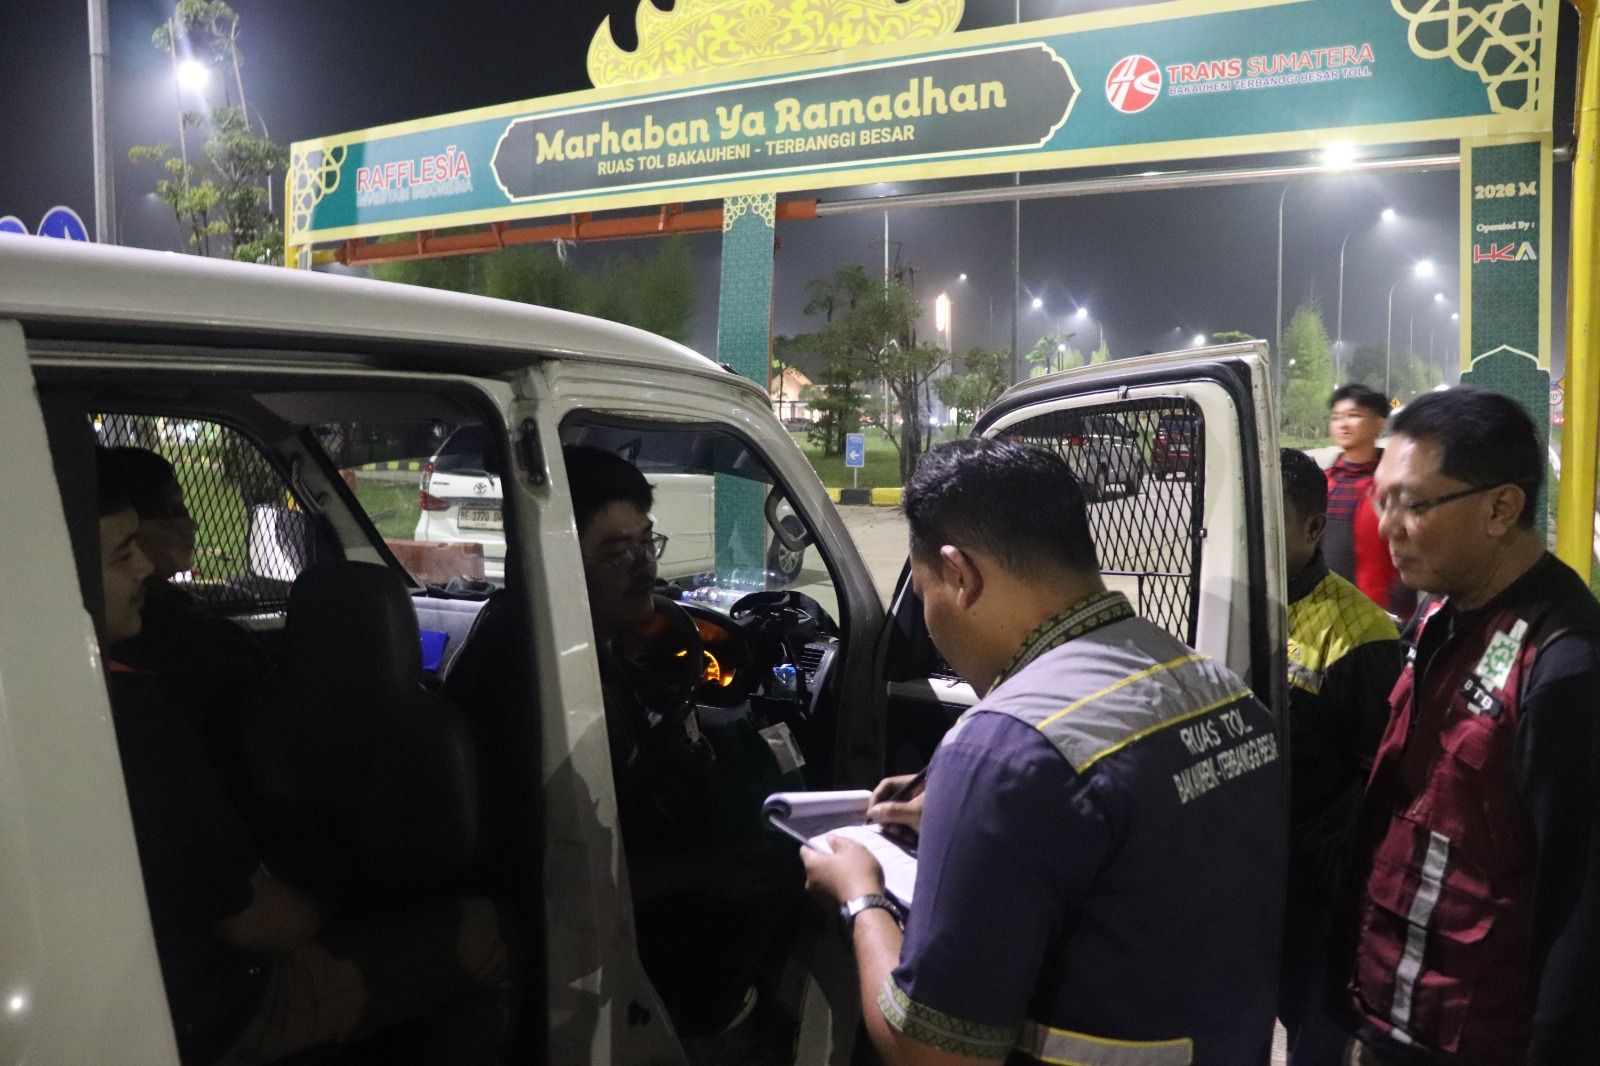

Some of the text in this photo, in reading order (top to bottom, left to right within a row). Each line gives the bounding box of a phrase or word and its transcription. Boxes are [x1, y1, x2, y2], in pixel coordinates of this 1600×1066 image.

[1166, 43, 1376, 84] TRANS SUMATERA
[1168, 78, 1232, 96] BAKAUHENI
[1300, 69, 1340, 83] BESAR
[1342, 66, 1373, 79] TOLL
[535, 76, 1008, 165] Marhaban Ya Ramadhan
[598, 157, 635, 176] RUAS
[637, 155, 664, 171] TOL
[667, 143, 751, 168] BAKAUHENI
[765, 131, 856, 157] TERBANGGI
[860, 124, 915, 146] BESAR
[1474, 181, 1537, 200] 2026 M
[1473, 241, 1537, 264] HKA
[1180, 708, 1253, 755] RUAS TOL
